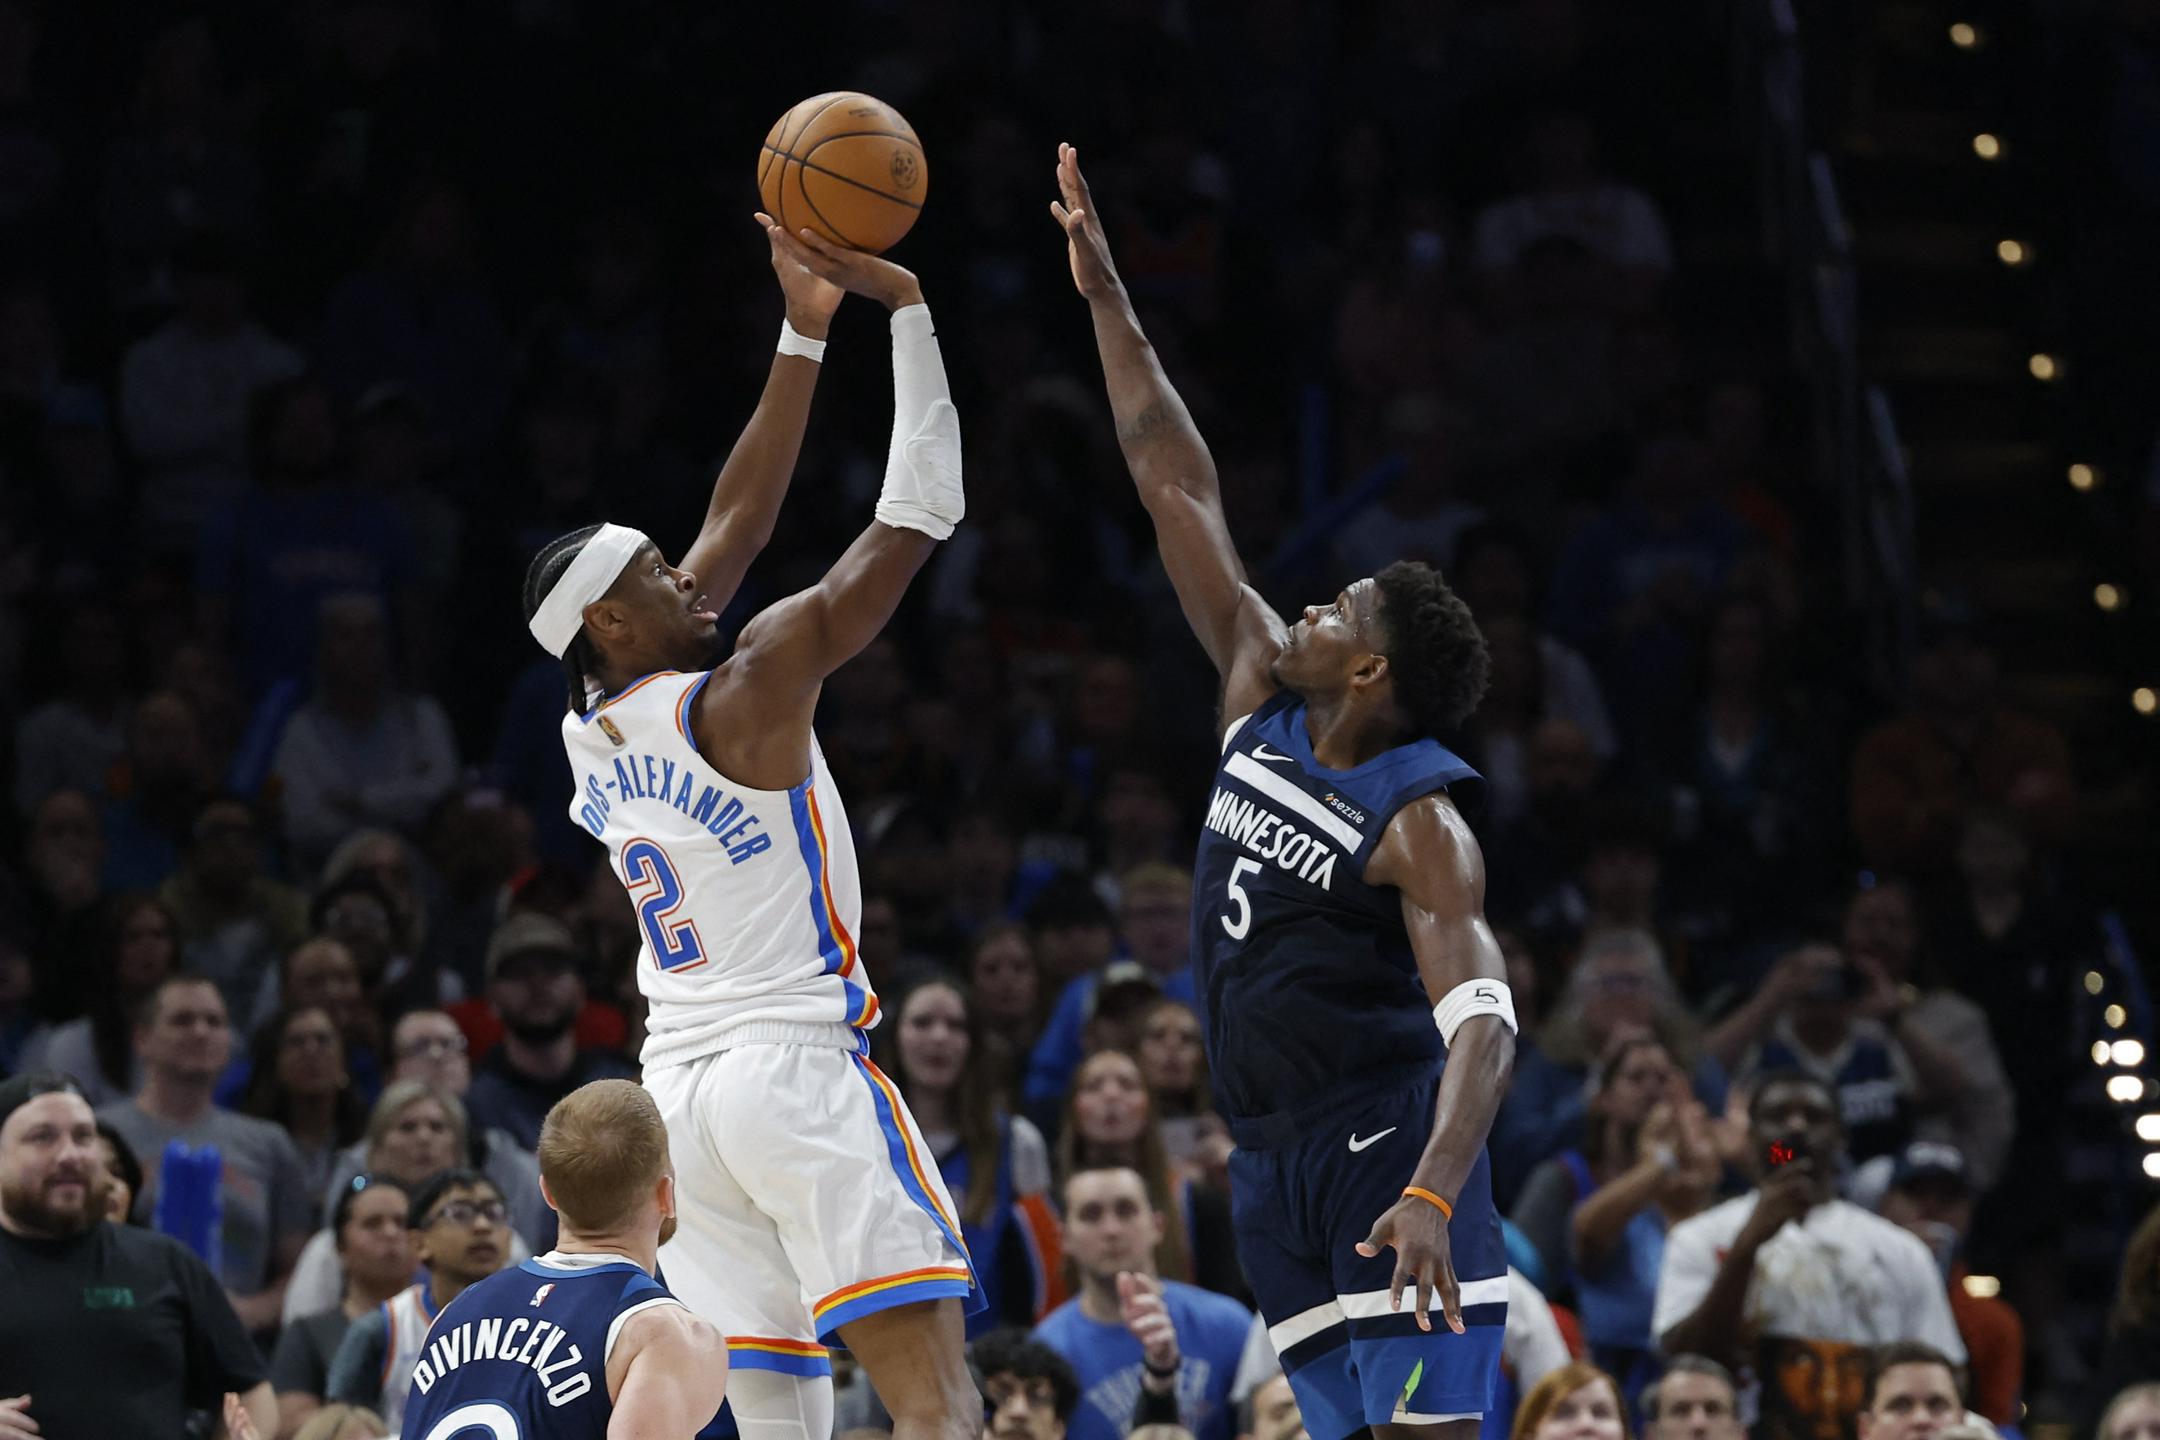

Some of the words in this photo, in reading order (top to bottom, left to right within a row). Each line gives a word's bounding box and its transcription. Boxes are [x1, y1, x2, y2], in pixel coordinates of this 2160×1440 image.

[1205, 786, 1338, 891] MINNESOTA
[1330, 798, 1364, 824] sezzle
[620, 836, 708, 973] 2
[1220, 856, 1263, 940] 5
[1475, 987, 1499, 1003] 5
[412, 1318, 591, 1407] DIVINCENZO
